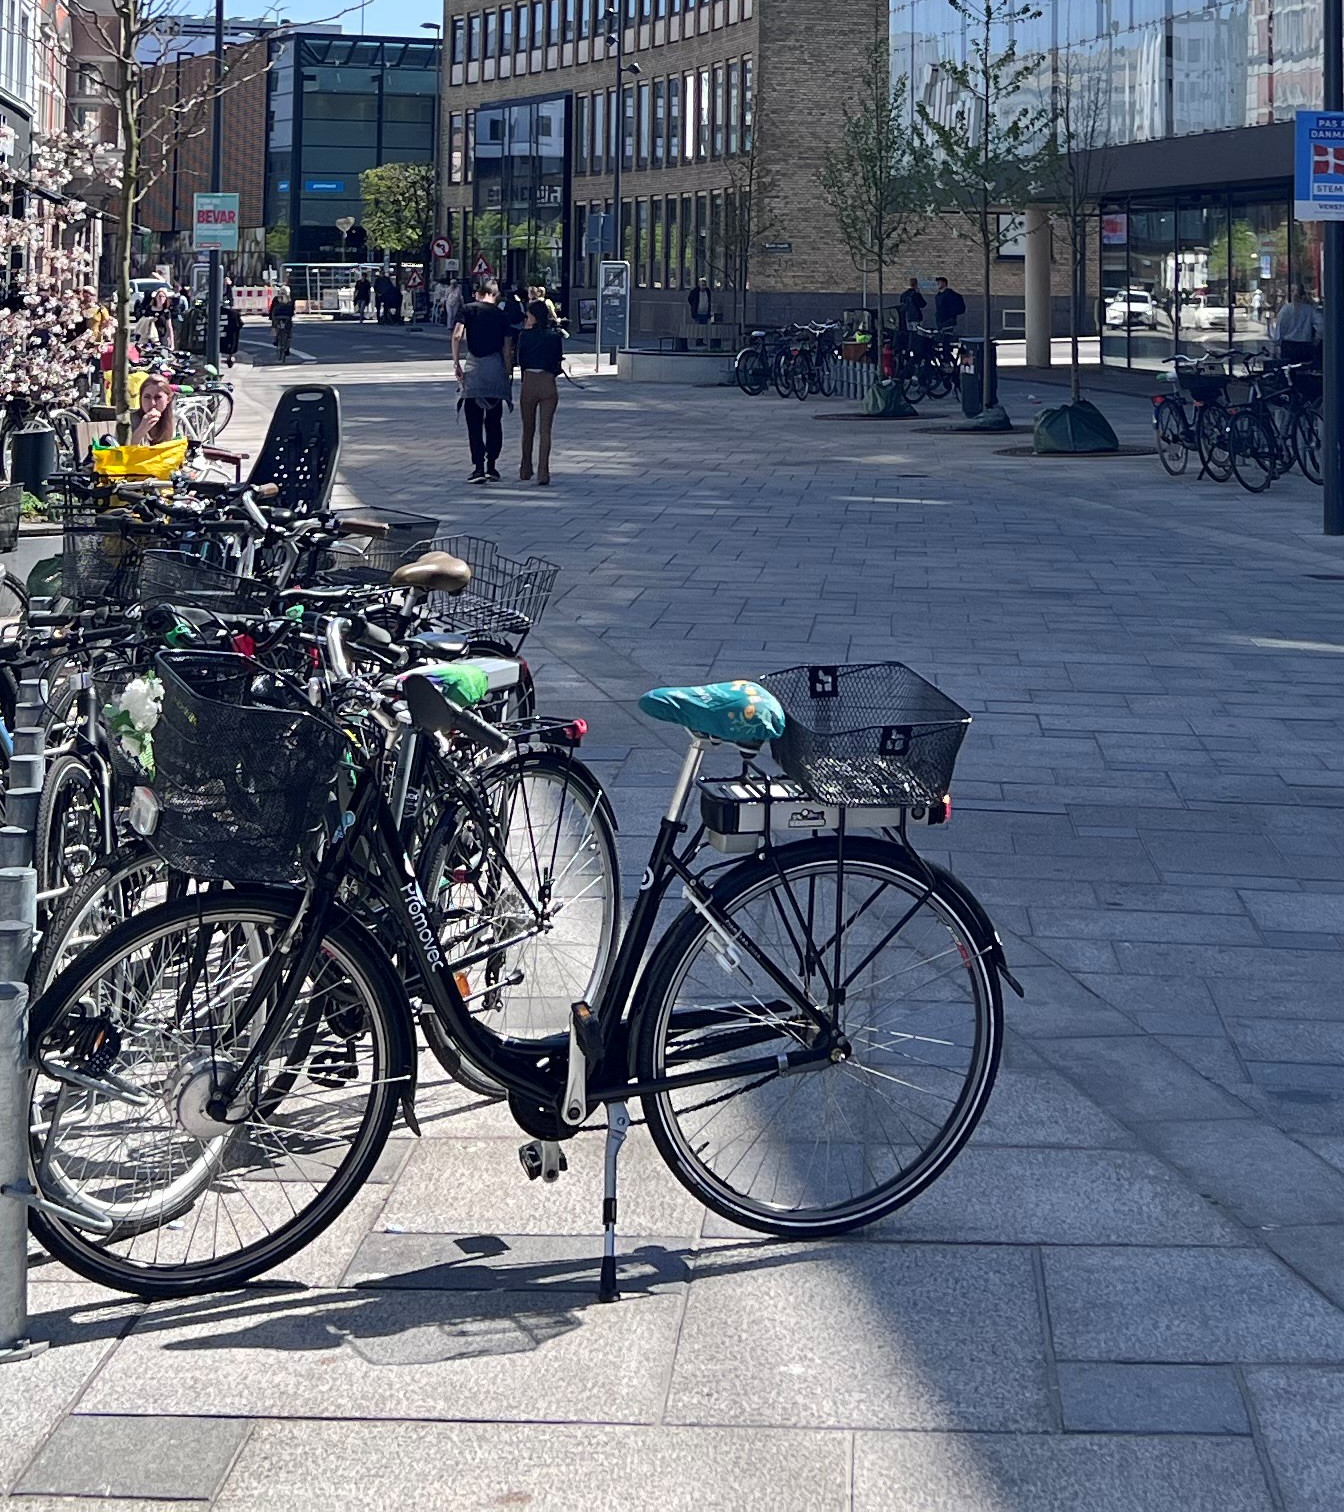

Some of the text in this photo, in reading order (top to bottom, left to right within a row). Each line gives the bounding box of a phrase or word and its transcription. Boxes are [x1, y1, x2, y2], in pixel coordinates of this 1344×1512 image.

[1318, 119, 1338, 128] PAS
[1316, 185, 1343, 193] STEM
[197, 209, 236, 224] BEVAR
[400, 882, 445, 973] Promovec
